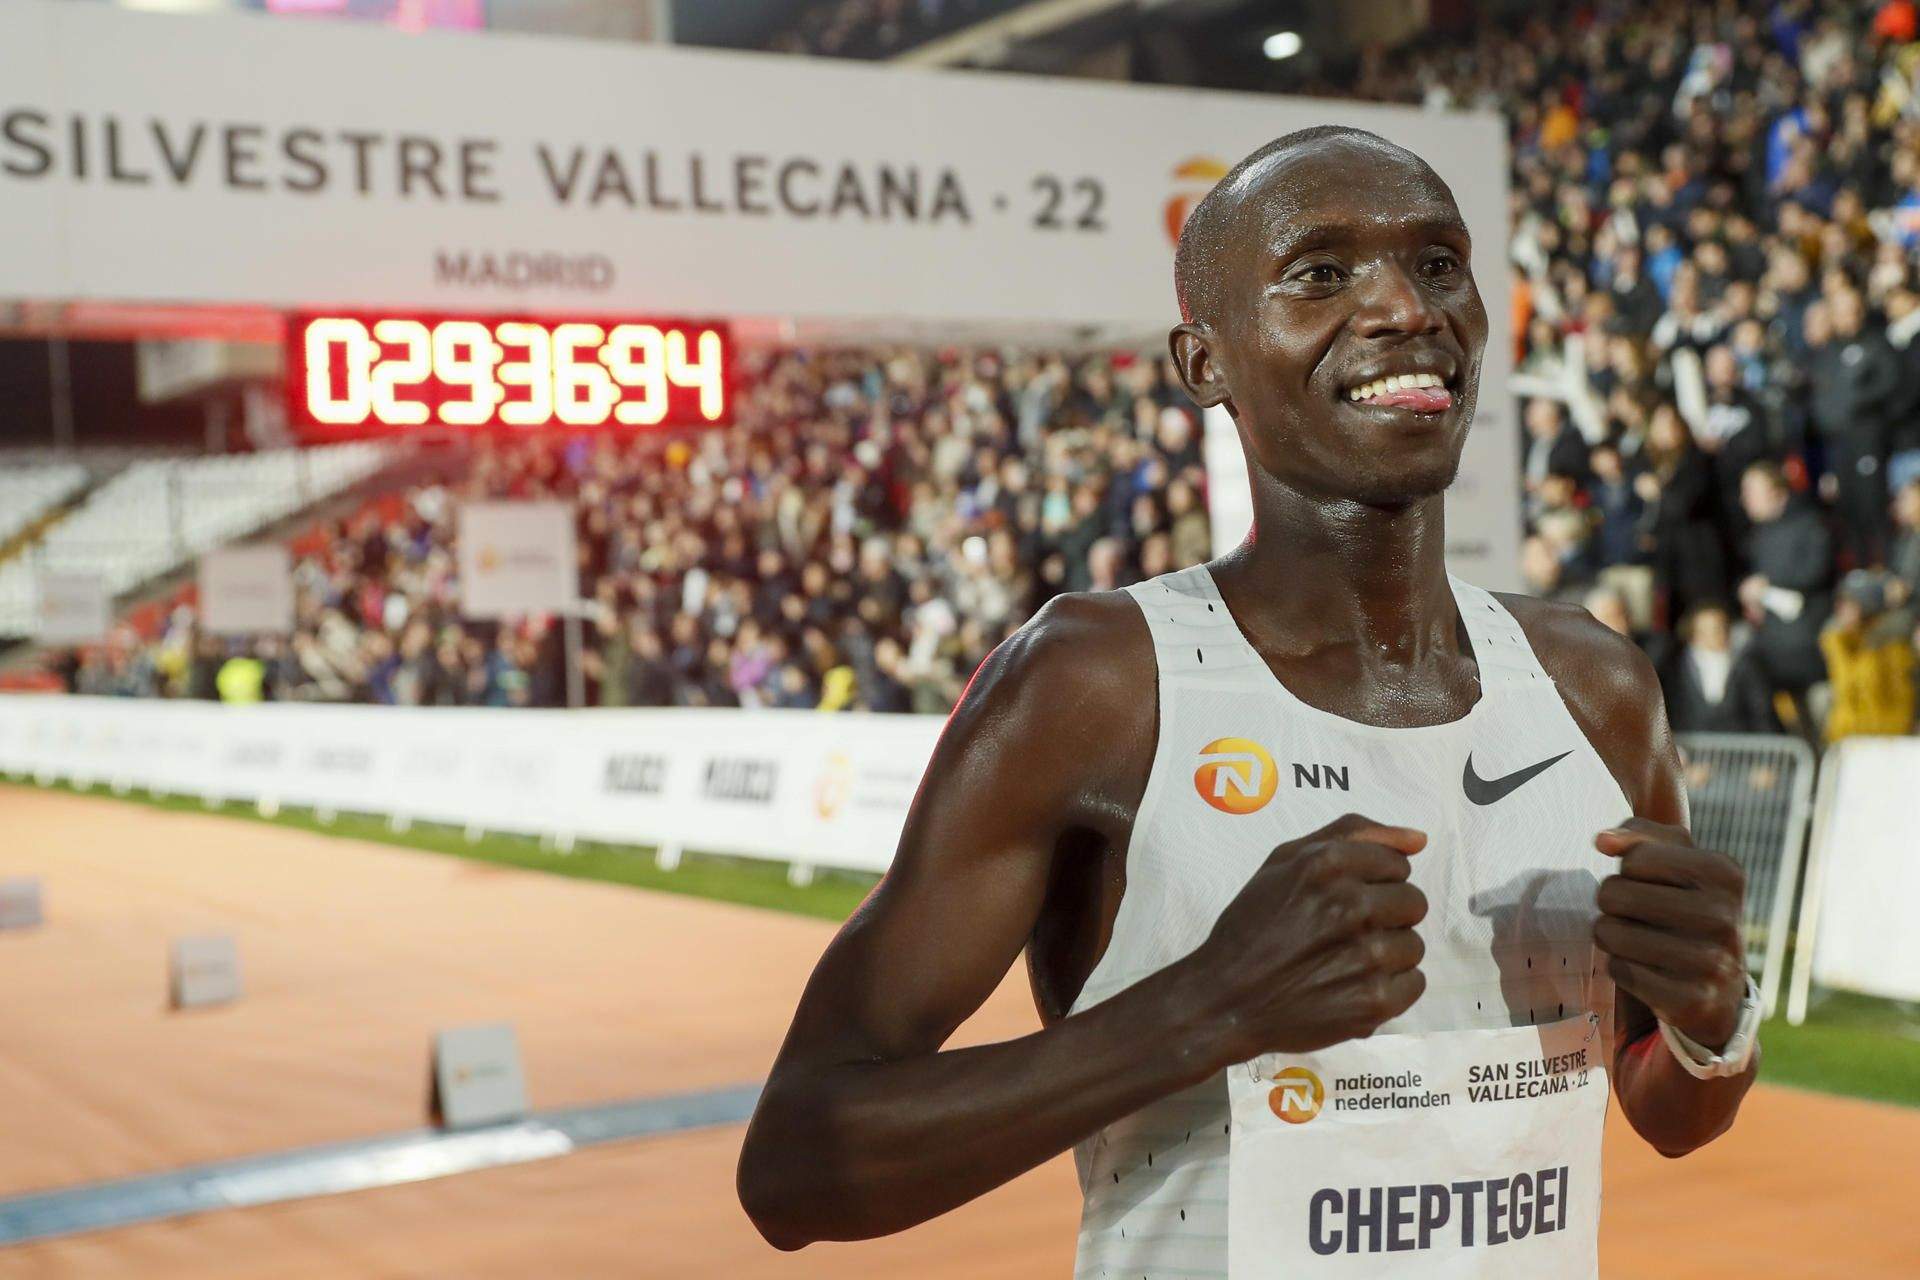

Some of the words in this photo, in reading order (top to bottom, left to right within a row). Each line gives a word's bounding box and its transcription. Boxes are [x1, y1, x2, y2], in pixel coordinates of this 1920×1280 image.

[2, 109, 501, 202] SILVESTRE
[537, 144, 972, 225] VALLECANA
[1033, 176, 1105, 232] 22
[435, 251, 614, 291] MADRID
[1292, 763, 1350, 791] NN
[1335, 1070, 1422, 1091] nationale
[1468, 1063, 1509, 1083] SAN
[1515, 1048, 1587, 1078] SILVESTRE
[1335, 1090, 1451, 1111] nederlanden
[1468, 1076, 1569, 1103] VALLECANA
[1577, 1070, 1589, 1088] 22
[1308, 1166, 1569, 1256] CHEPTEGEI
